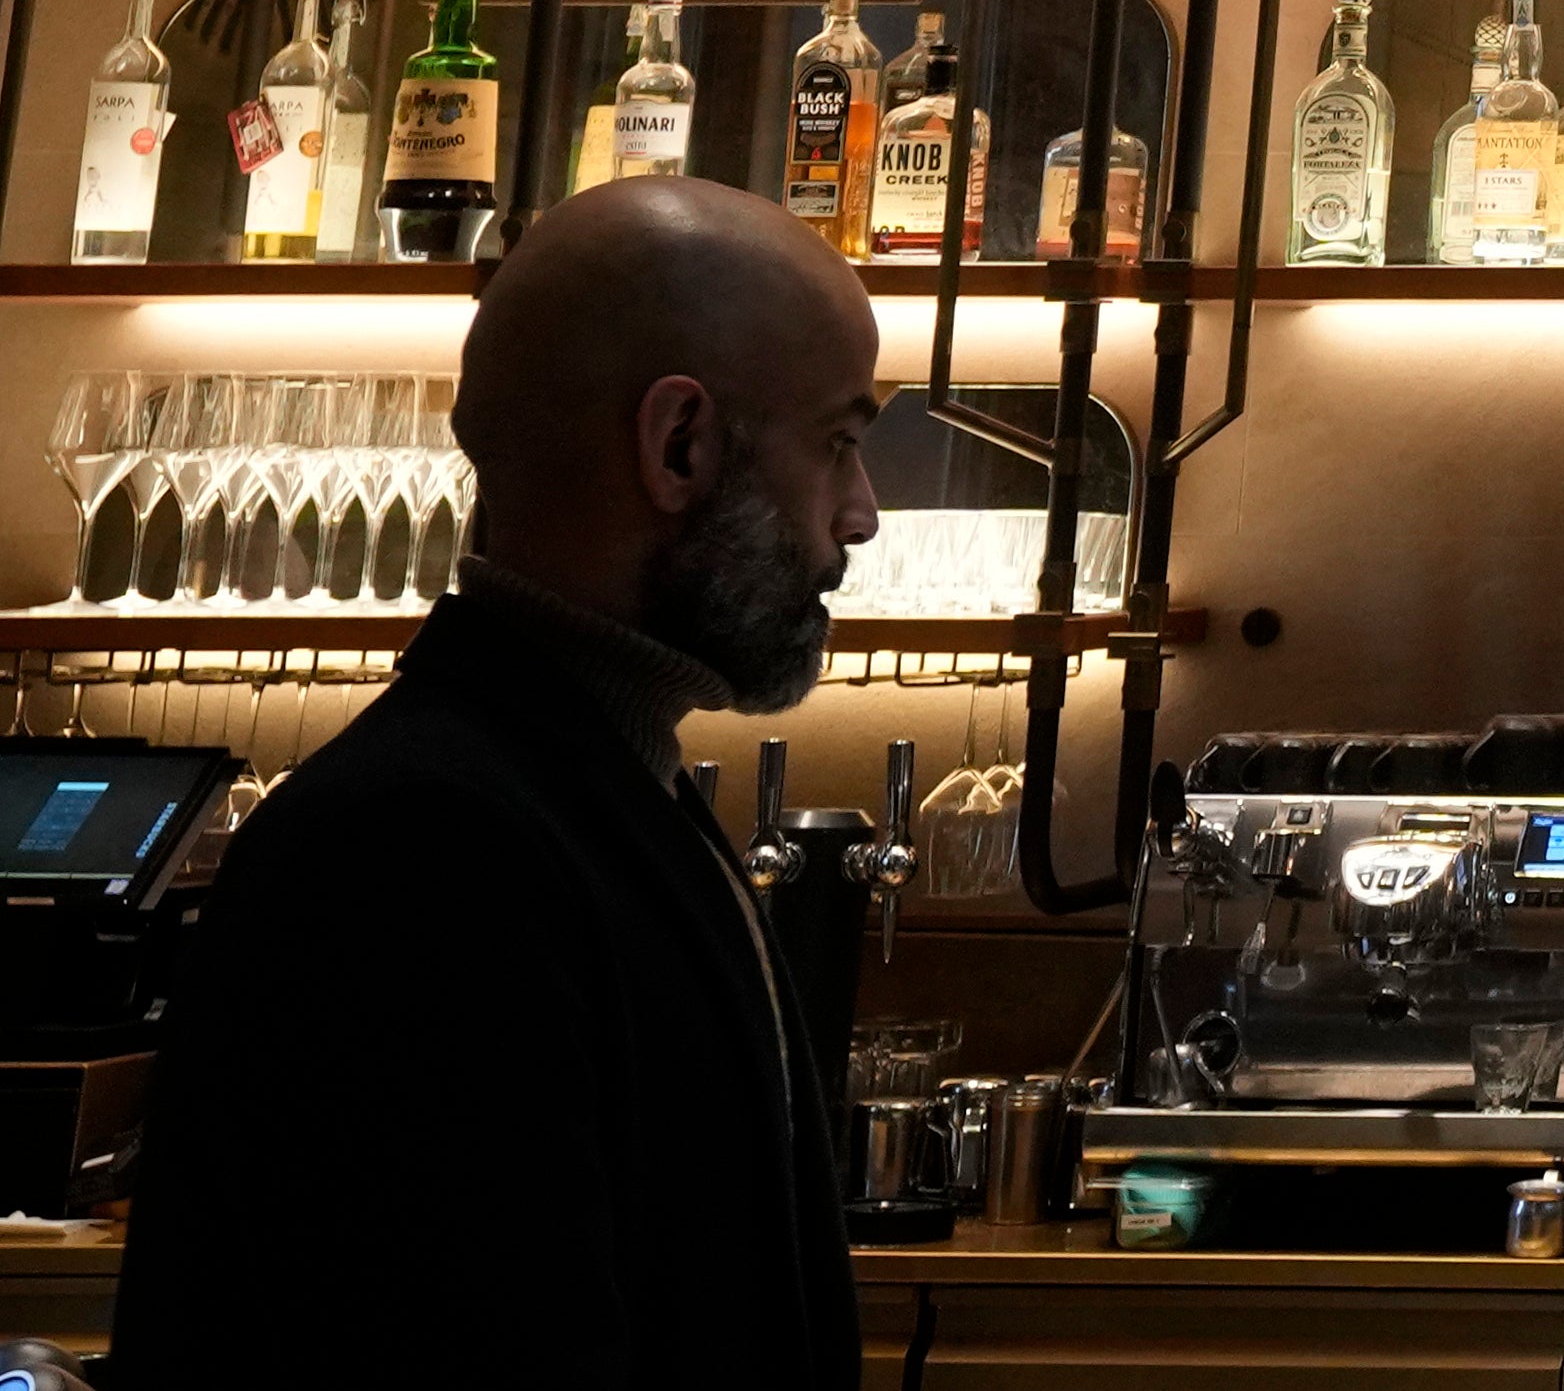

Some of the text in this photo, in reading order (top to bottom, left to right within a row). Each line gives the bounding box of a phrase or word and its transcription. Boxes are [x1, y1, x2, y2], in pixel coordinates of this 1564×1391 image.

[95, 95, 136, 109] SARPA
[797, 91, 845, 105] BLACK
[269, 100, 304, 111] ARPA
[800, 103, 840, 116] BUSH
[1477, 137, 1543, 149] LANTATION
[880, 142, 943, 172] KNOB
[885, 174, 950, 186] CREEK
